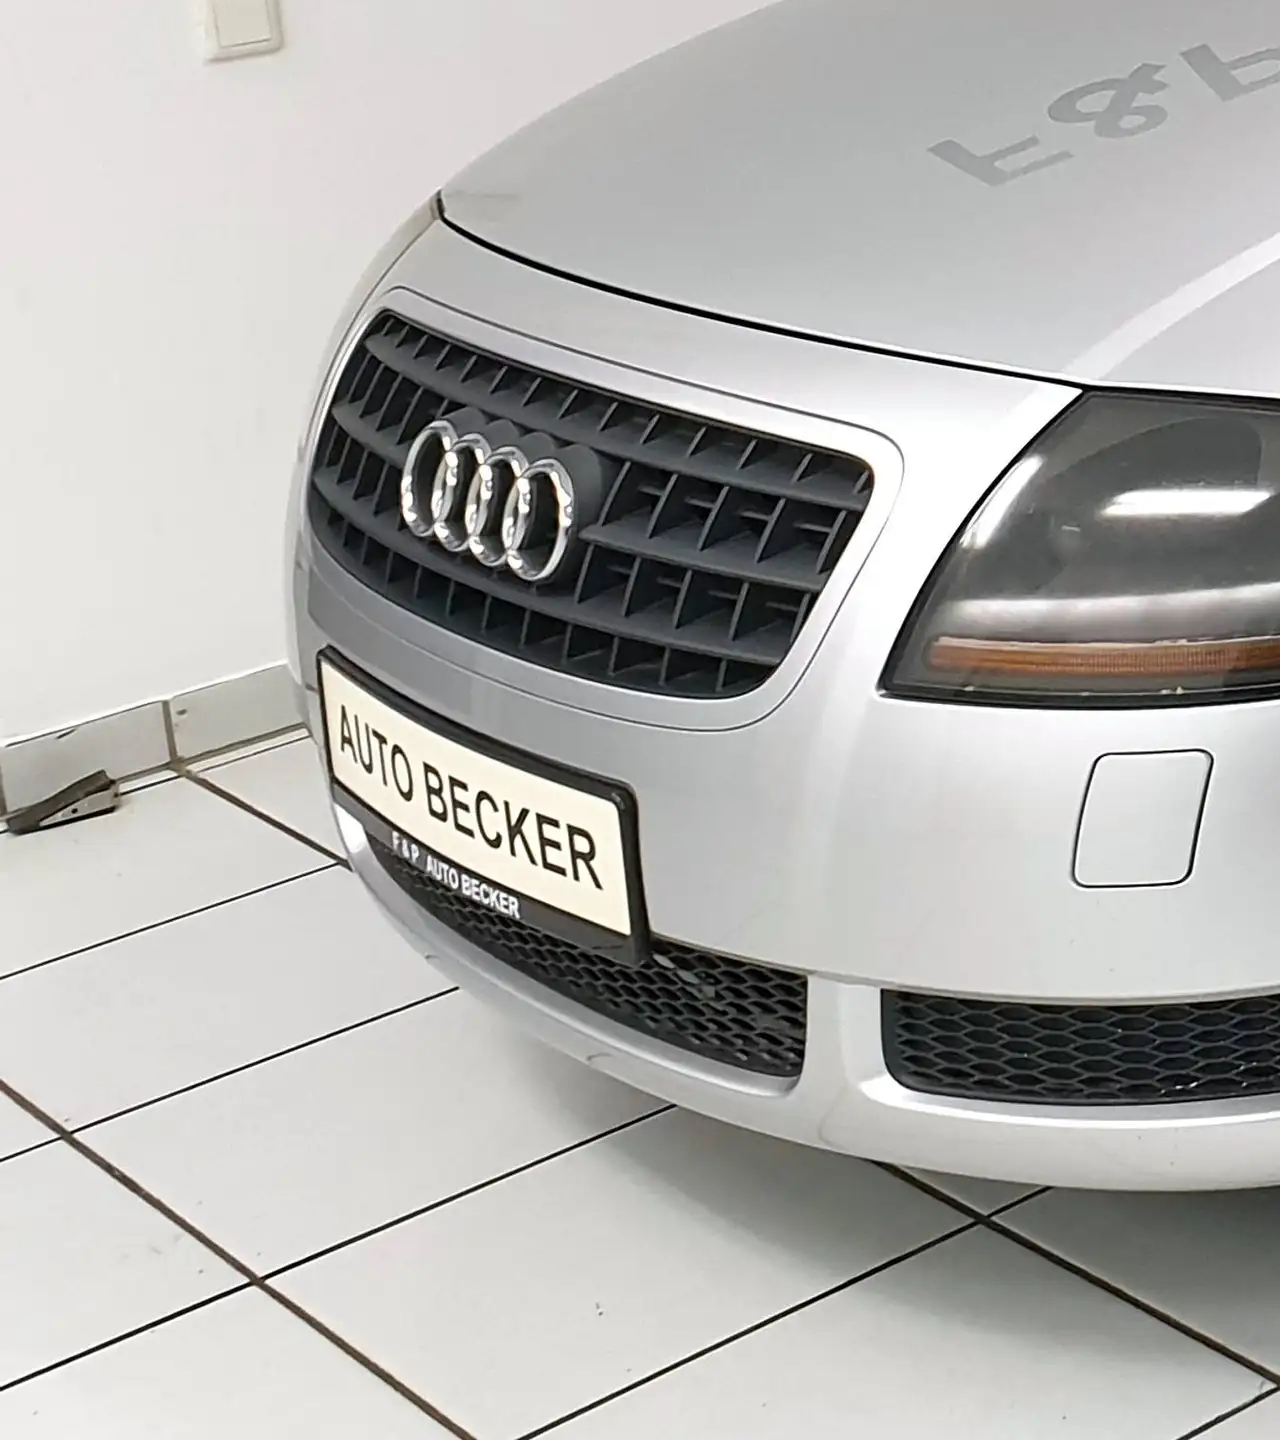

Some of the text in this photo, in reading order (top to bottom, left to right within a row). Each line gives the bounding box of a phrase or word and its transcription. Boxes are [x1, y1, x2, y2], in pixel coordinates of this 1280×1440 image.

[340, 704, 605, 892] AUTO BECKER
[426, 853, 459, 890] AUTO
[460, 872, 521, 920] BECKER
